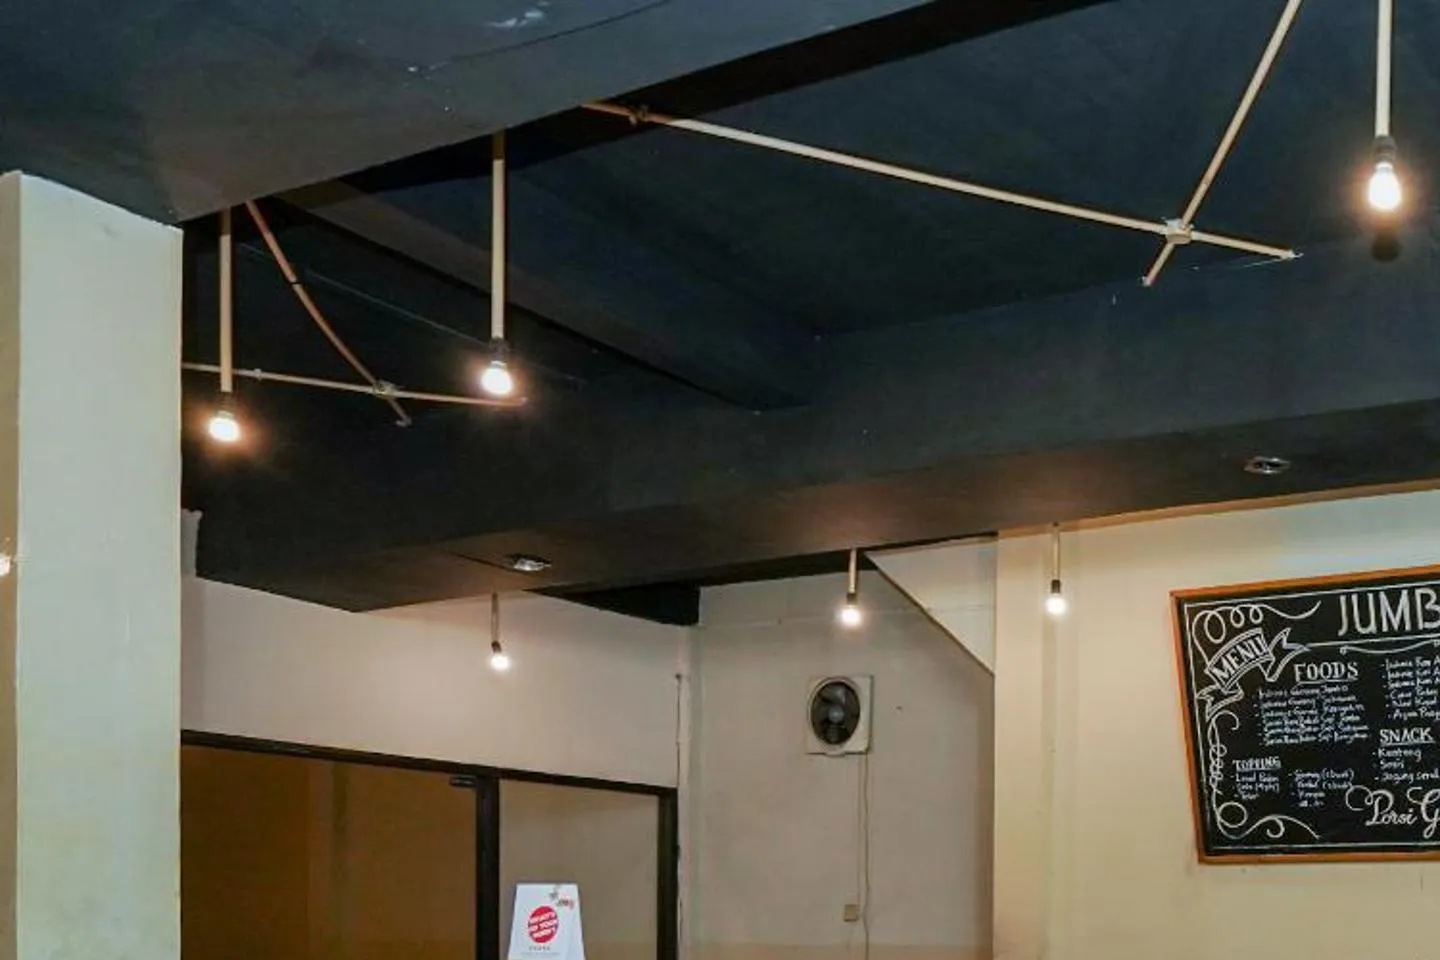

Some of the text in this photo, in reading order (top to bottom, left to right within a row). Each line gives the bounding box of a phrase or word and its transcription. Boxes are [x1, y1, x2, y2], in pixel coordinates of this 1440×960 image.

[1212, 636, 1268, 685] MENU
[1294, 661, 1359, 683] FOODS
[1380, 727, 1435, 744] SNACK
[1346, 785, 1419, 827] Porsi
